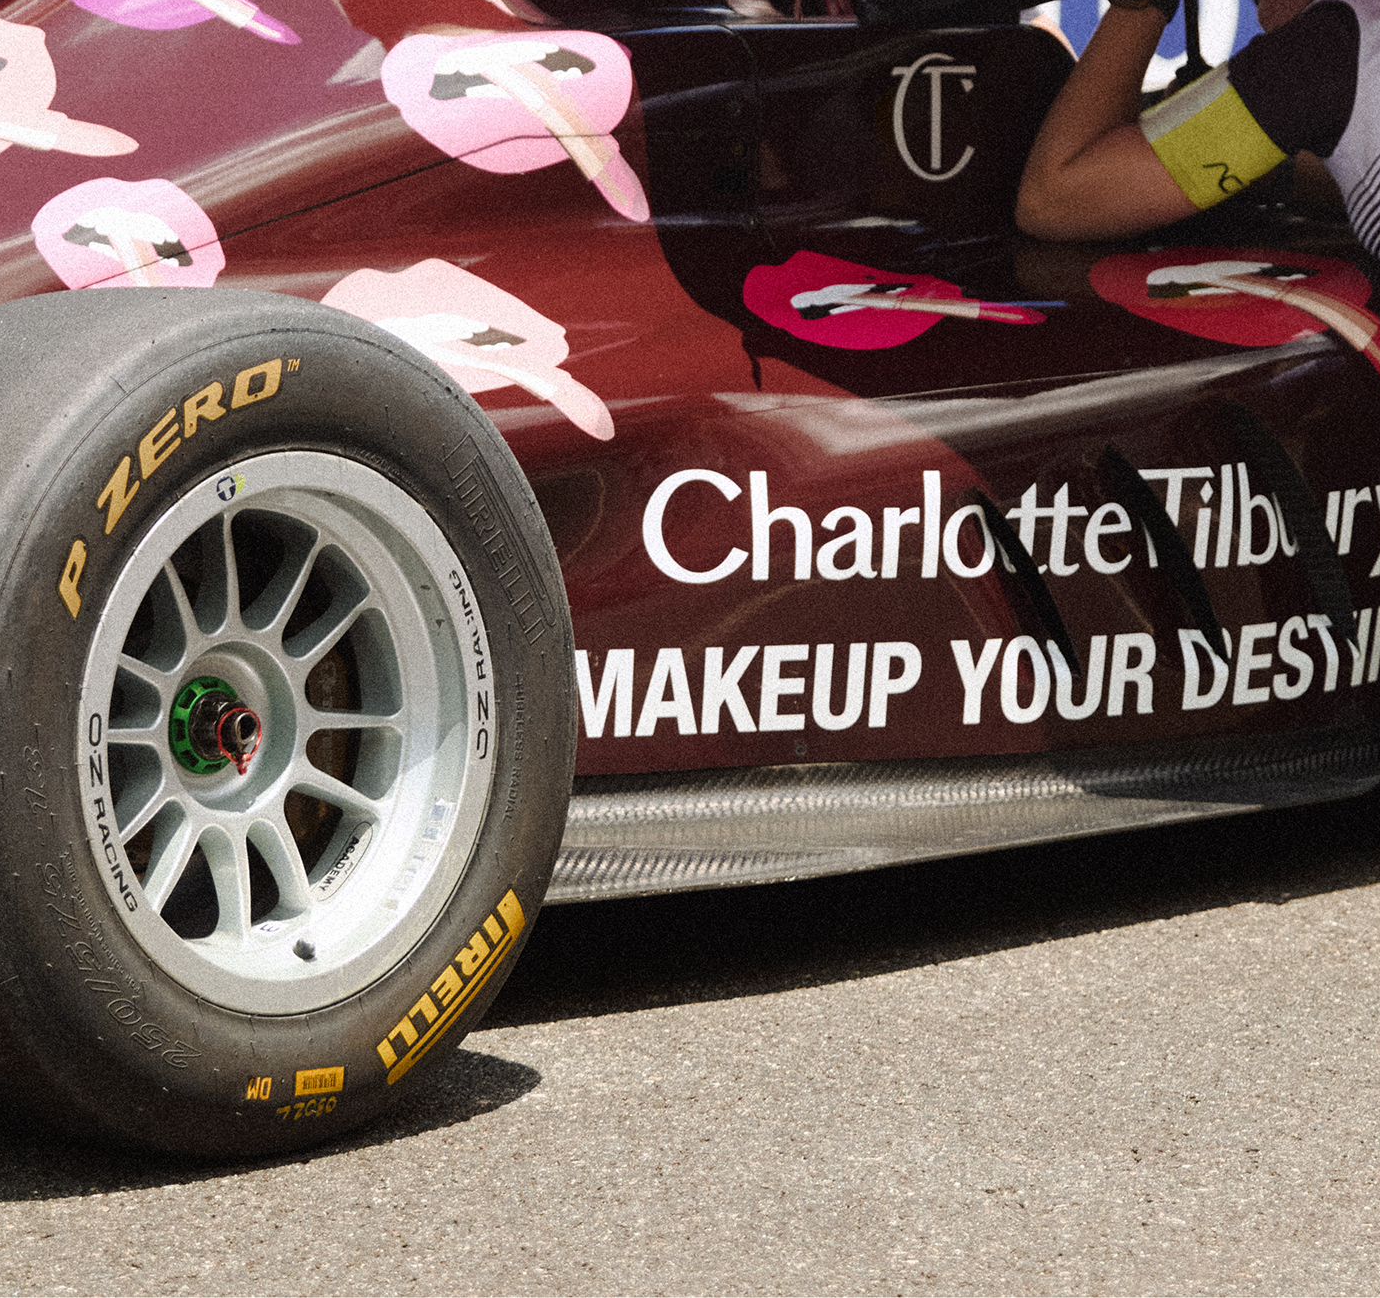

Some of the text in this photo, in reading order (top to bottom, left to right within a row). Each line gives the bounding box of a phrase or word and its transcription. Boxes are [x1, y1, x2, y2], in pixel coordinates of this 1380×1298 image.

[58, 539, 87, 619] P
[96, 358, 283, 535] ZERO
[575, 640, 922, 738] MAKEUP
[951, 631, 1157, 726] YOUR
[93, 796, 139, 914] RACING
[319, 835, 360, 892] ACADEMY
[375, 888, 526, 1086] PIRELLI
[246, 1076, 272, 1101] DM
